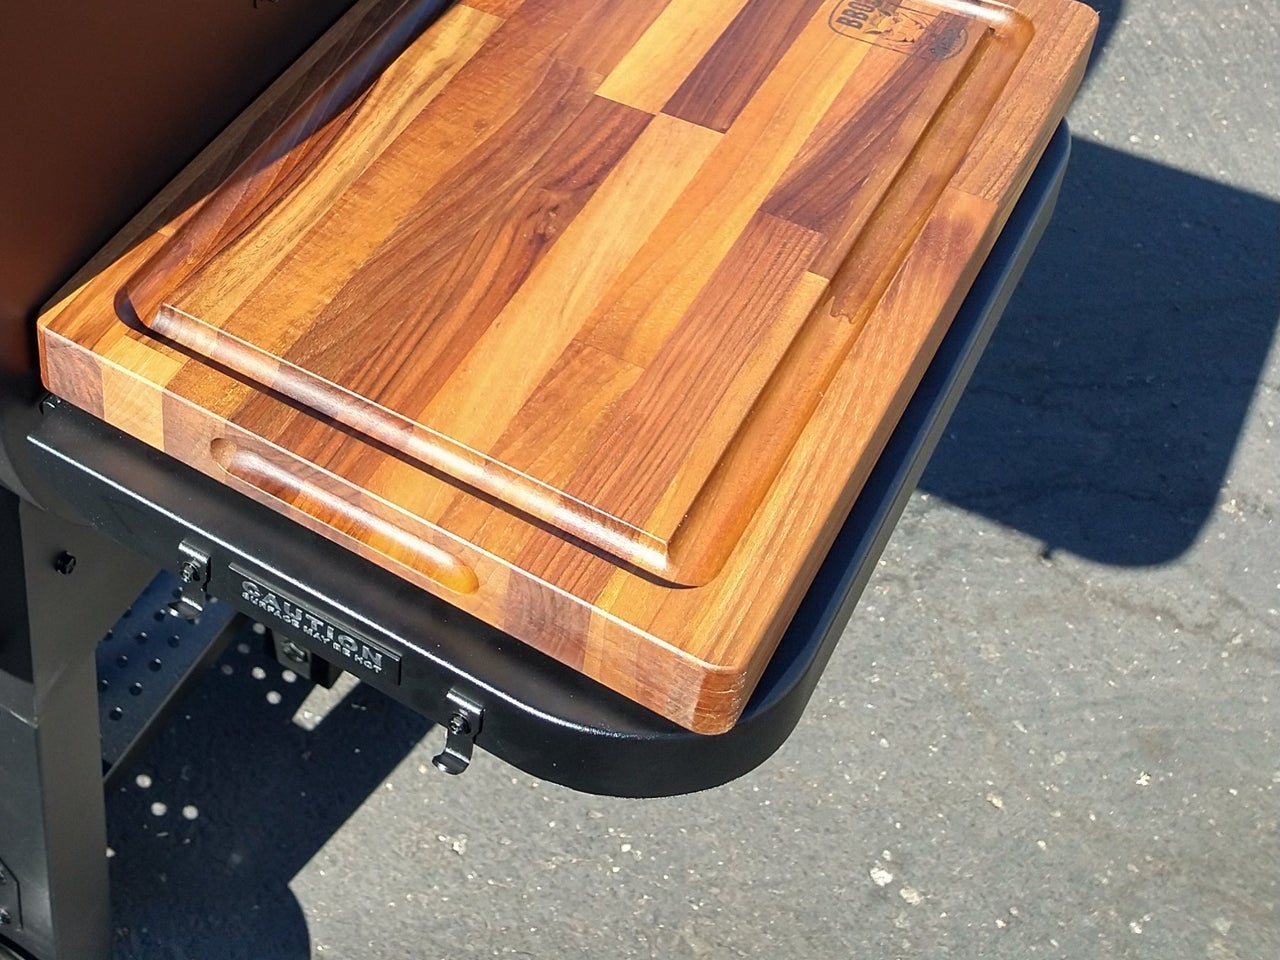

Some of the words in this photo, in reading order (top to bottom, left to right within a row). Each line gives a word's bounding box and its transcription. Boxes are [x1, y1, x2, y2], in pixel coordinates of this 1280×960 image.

[241, 580, 383, 667] CAUTION
[302, 624, 331, 645] MAY
[332, 641, 351, 658] BE
[354, 653, 383, 674] HOT
